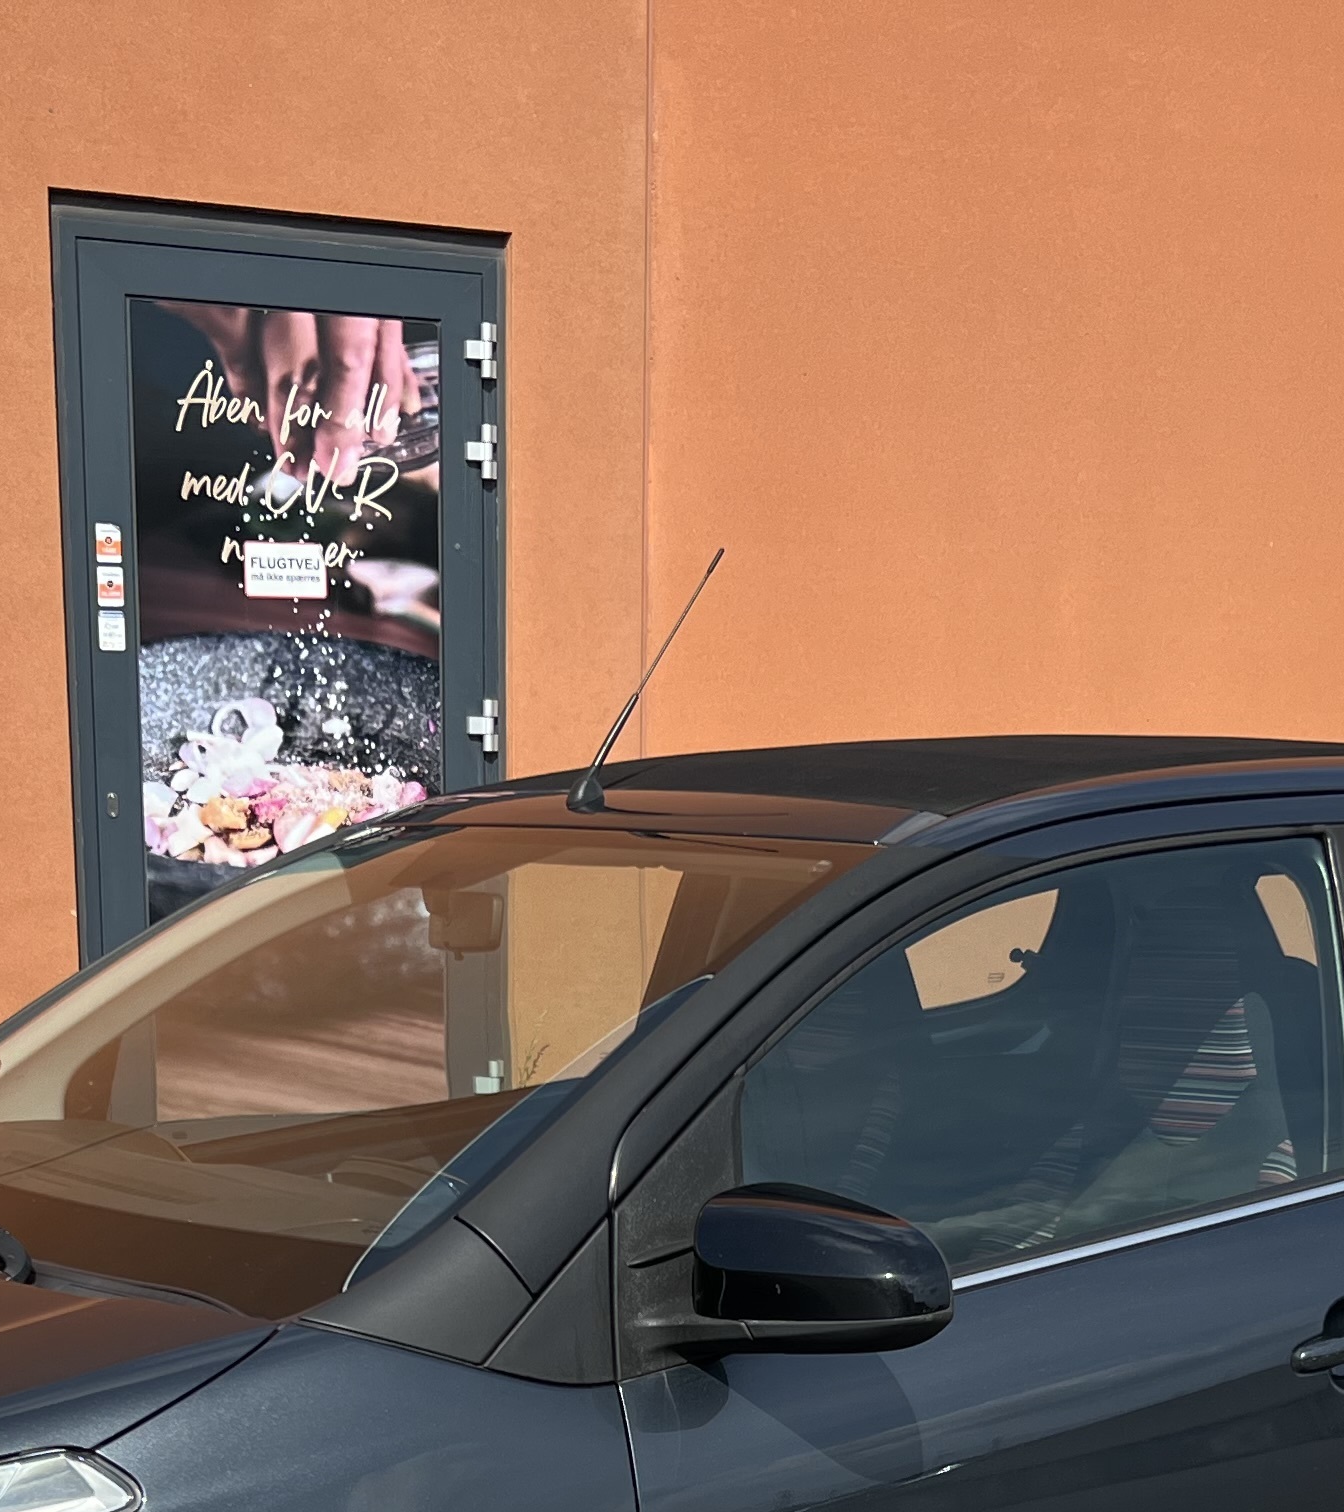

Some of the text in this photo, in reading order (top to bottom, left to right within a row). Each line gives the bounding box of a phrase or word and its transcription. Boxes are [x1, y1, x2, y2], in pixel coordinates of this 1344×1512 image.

[175, 359, 402, 446] Åben for alle
[181, 461, 250, 507] med
[250, 556, 321, 571] FLUGTVEJ
[250, 572, 264, 582] må
[266, 573, 284, 582] ikke
